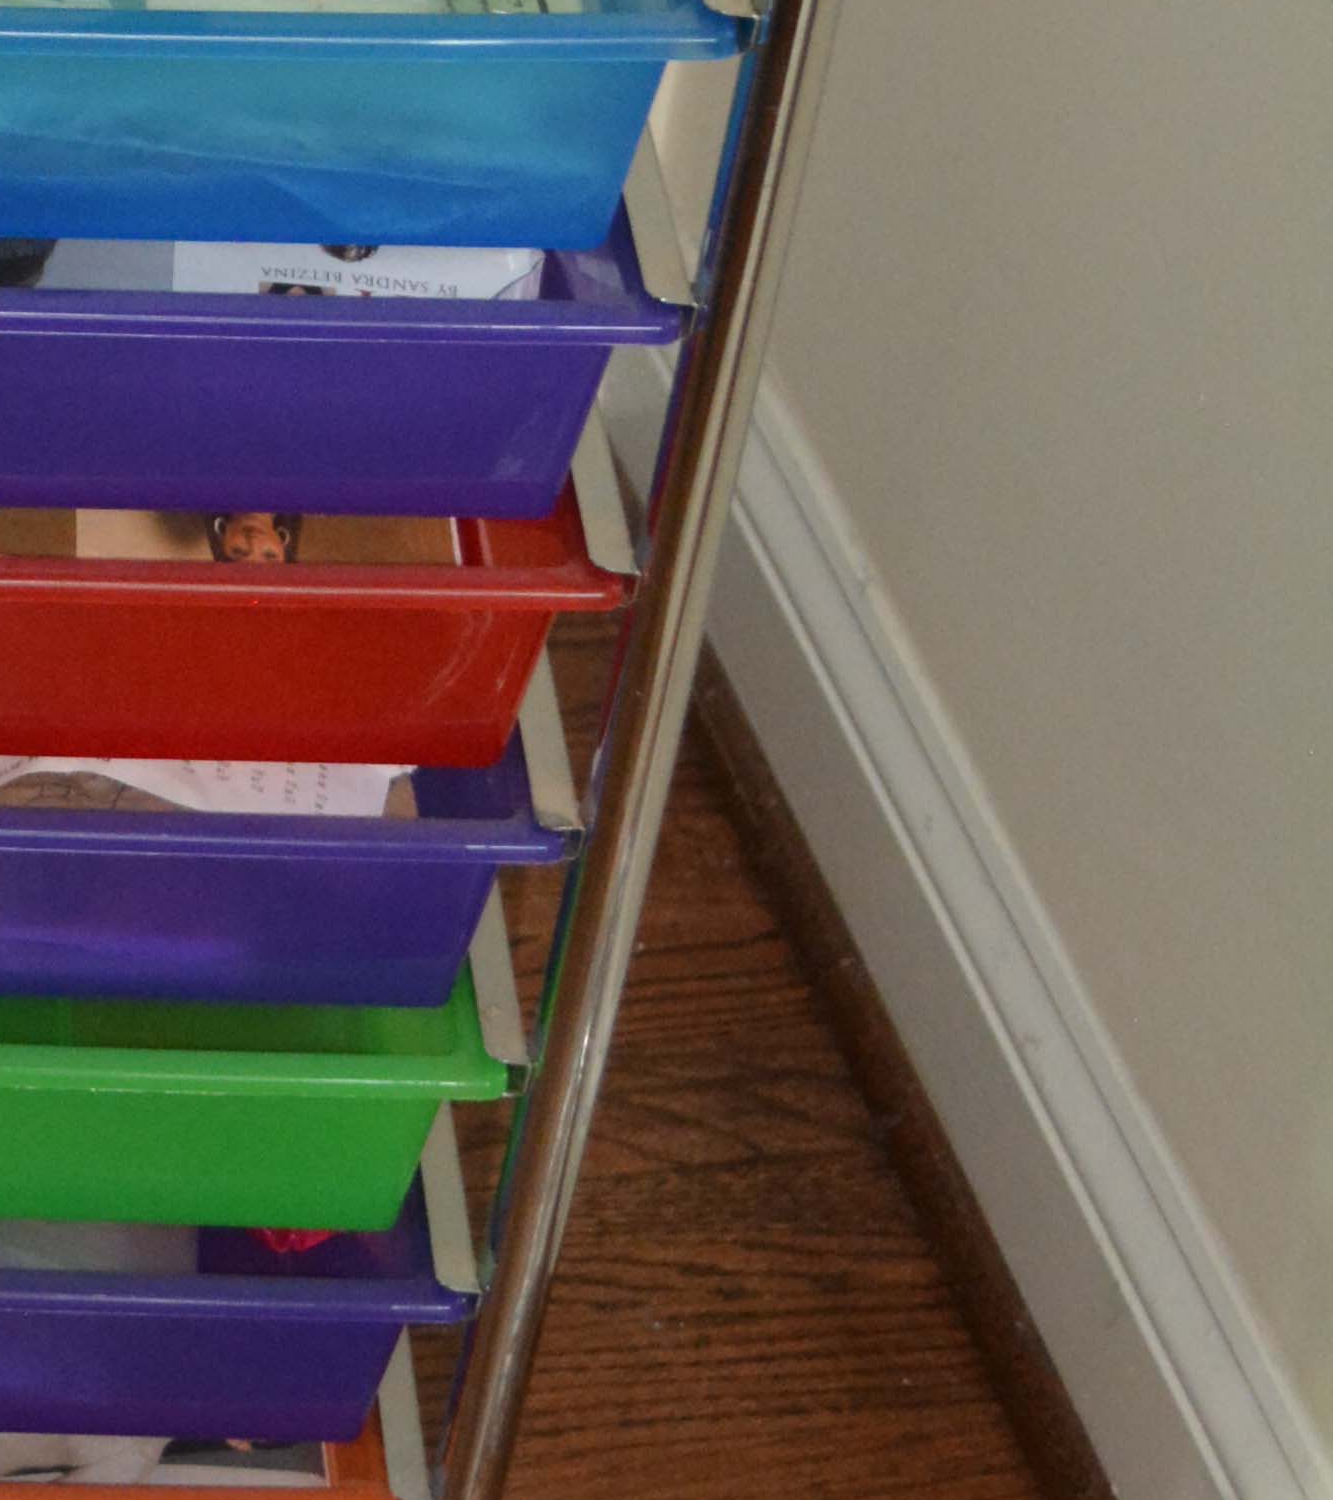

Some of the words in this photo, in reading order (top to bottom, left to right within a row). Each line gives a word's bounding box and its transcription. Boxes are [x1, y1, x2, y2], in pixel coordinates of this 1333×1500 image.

[260, 265, 343, 283] BETZINA
[350, 272, 430, 293] SANDRA
[437, 283, 459, 297] BY
